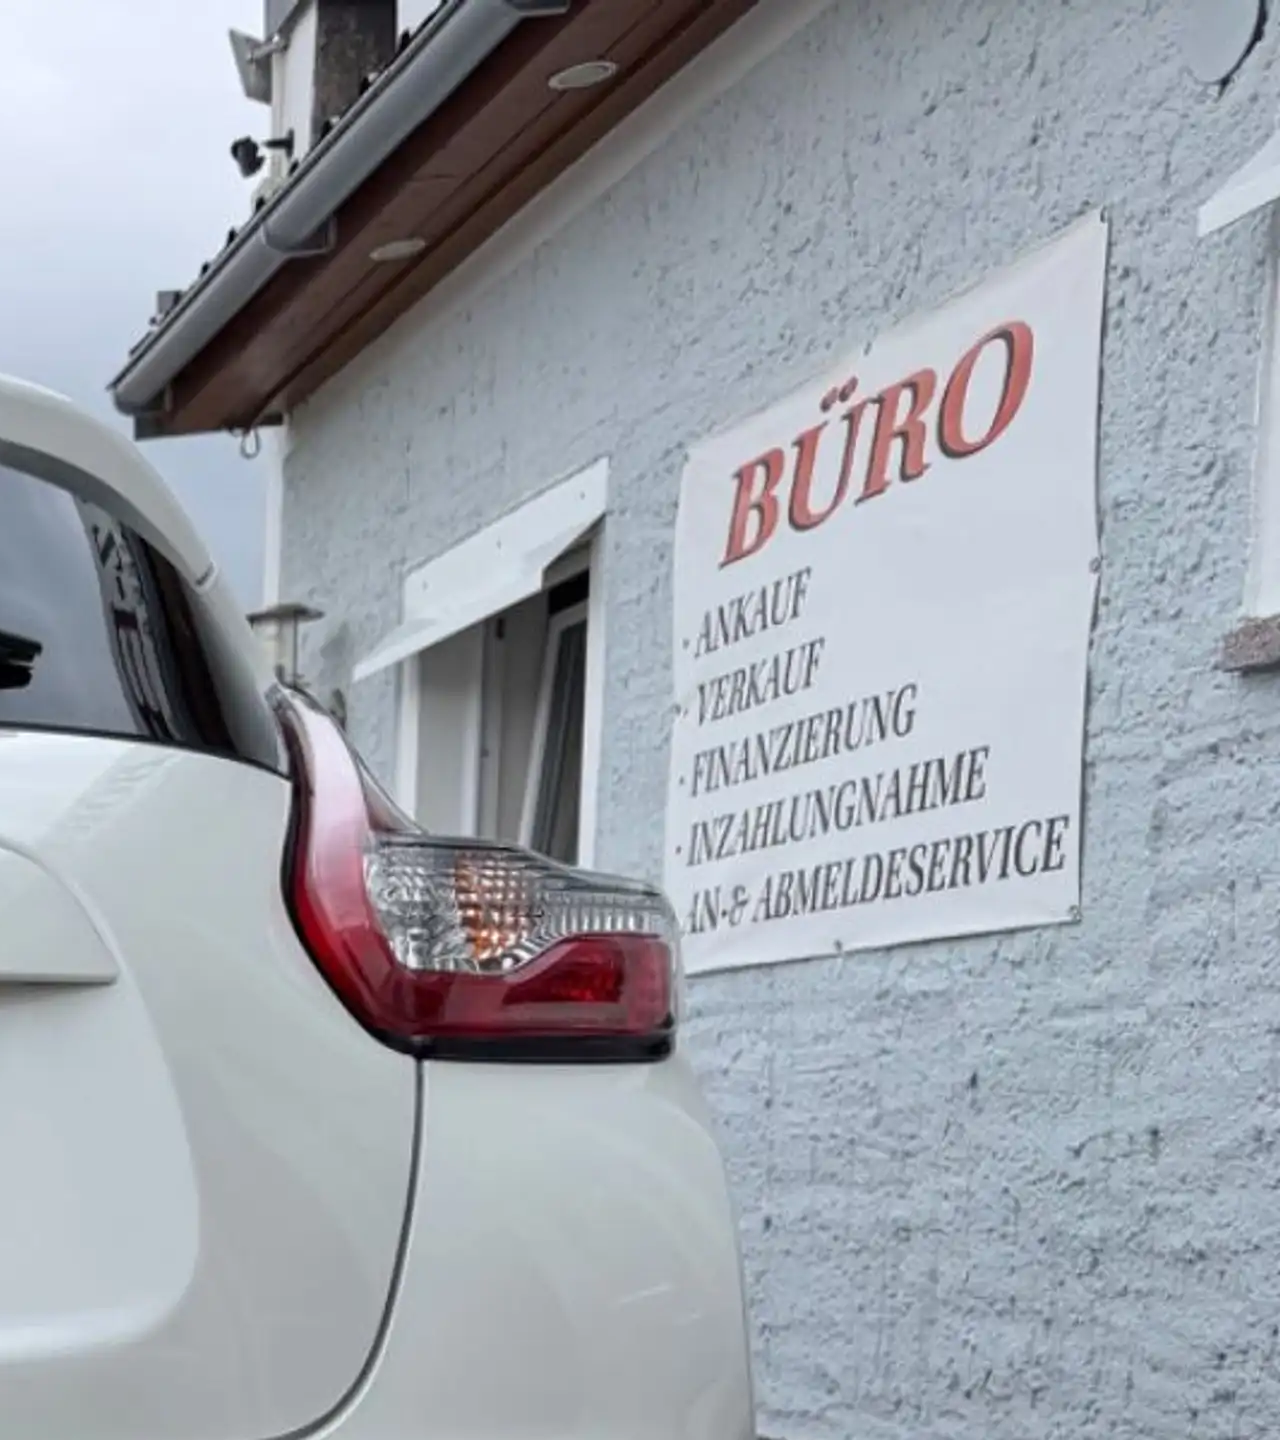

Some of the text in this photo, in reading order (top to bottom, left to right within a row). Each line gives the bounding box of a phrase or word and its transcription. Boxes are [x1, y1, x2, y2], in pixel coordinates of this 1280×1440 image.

[719, 320, 1034, 569] BÜRO
[694, 565, 812, 659] ANKAUF
[697, 636, 826, 726] VERKAUF
[690, 683, 918, 797] FINANZIERUNG
[686, 745, 990, 867] INZAHLUNGNAHME
[751, 814, 1071, 923] ABMELDESERVICE
